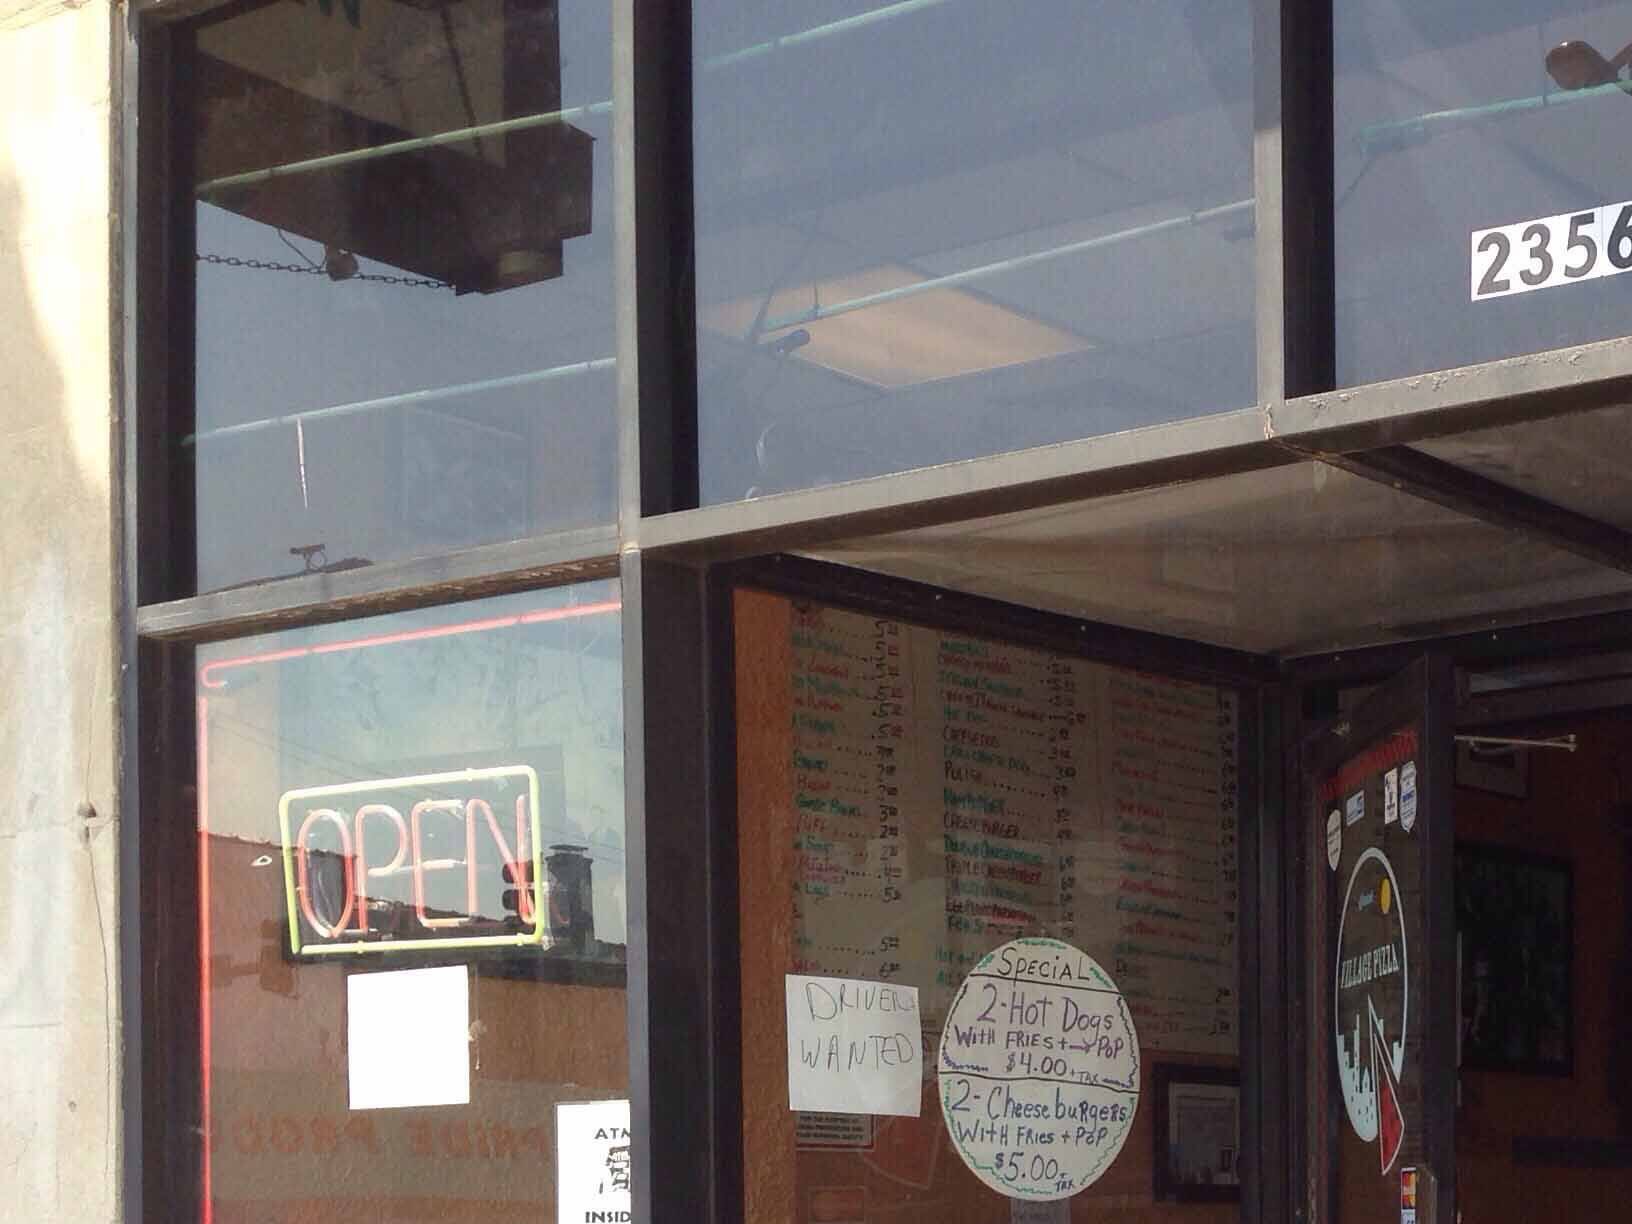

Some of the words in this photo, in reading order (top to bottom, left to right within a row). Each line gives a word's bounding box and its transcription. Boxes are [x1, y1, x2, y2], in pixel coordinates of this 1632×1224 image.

[297, 793, 538, 938] OPEN
[1373, 944, 1400, 979] PIZZA
[801, 1033, 914, 1073] WANTED
[1006, 1051, 1068, 1075] $4.00
[995, 1151, 1058, 1182] $5.00
